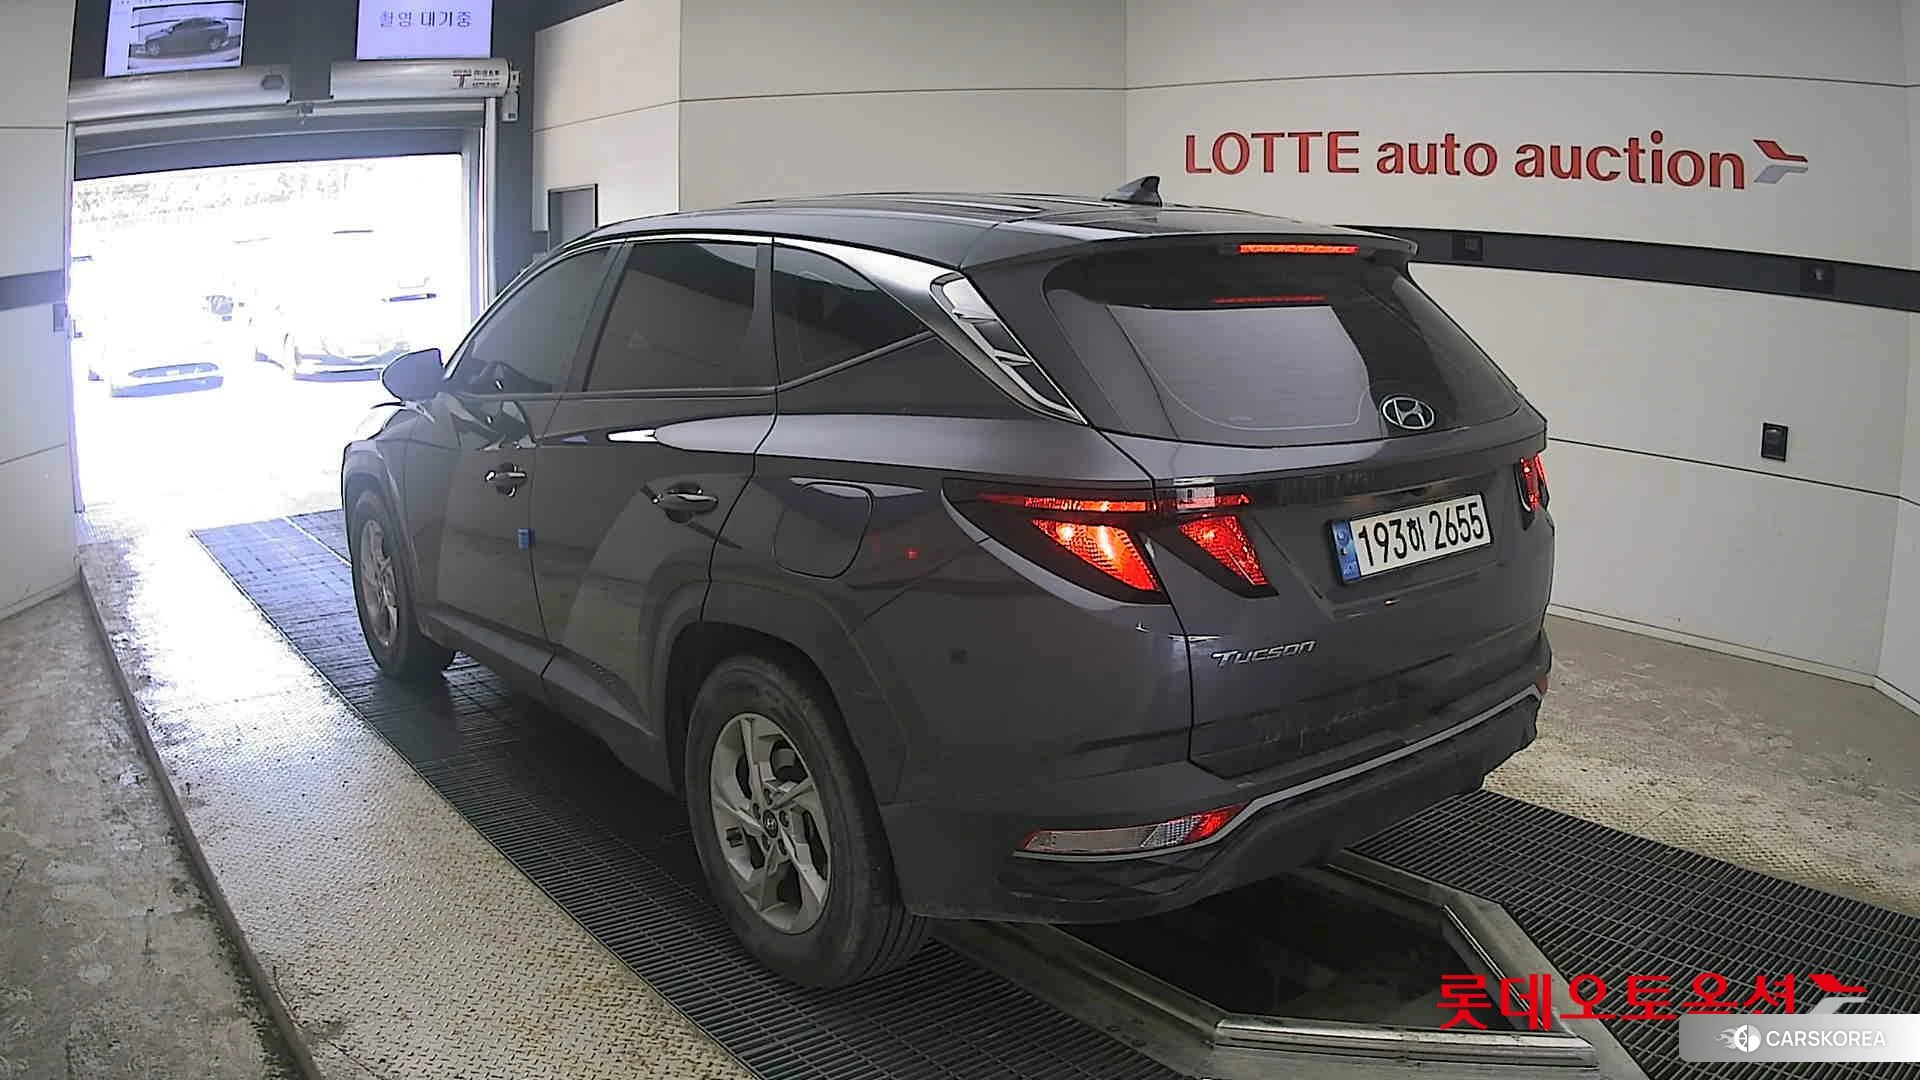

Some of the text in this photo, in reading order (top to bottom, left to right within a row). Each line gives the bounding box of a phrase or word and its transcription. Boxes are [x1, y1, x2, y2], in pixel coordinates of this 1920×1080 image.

[420, 9, 473, 28] 대기중
[1185, 131, 1746, 189] LOTTE auto auction
